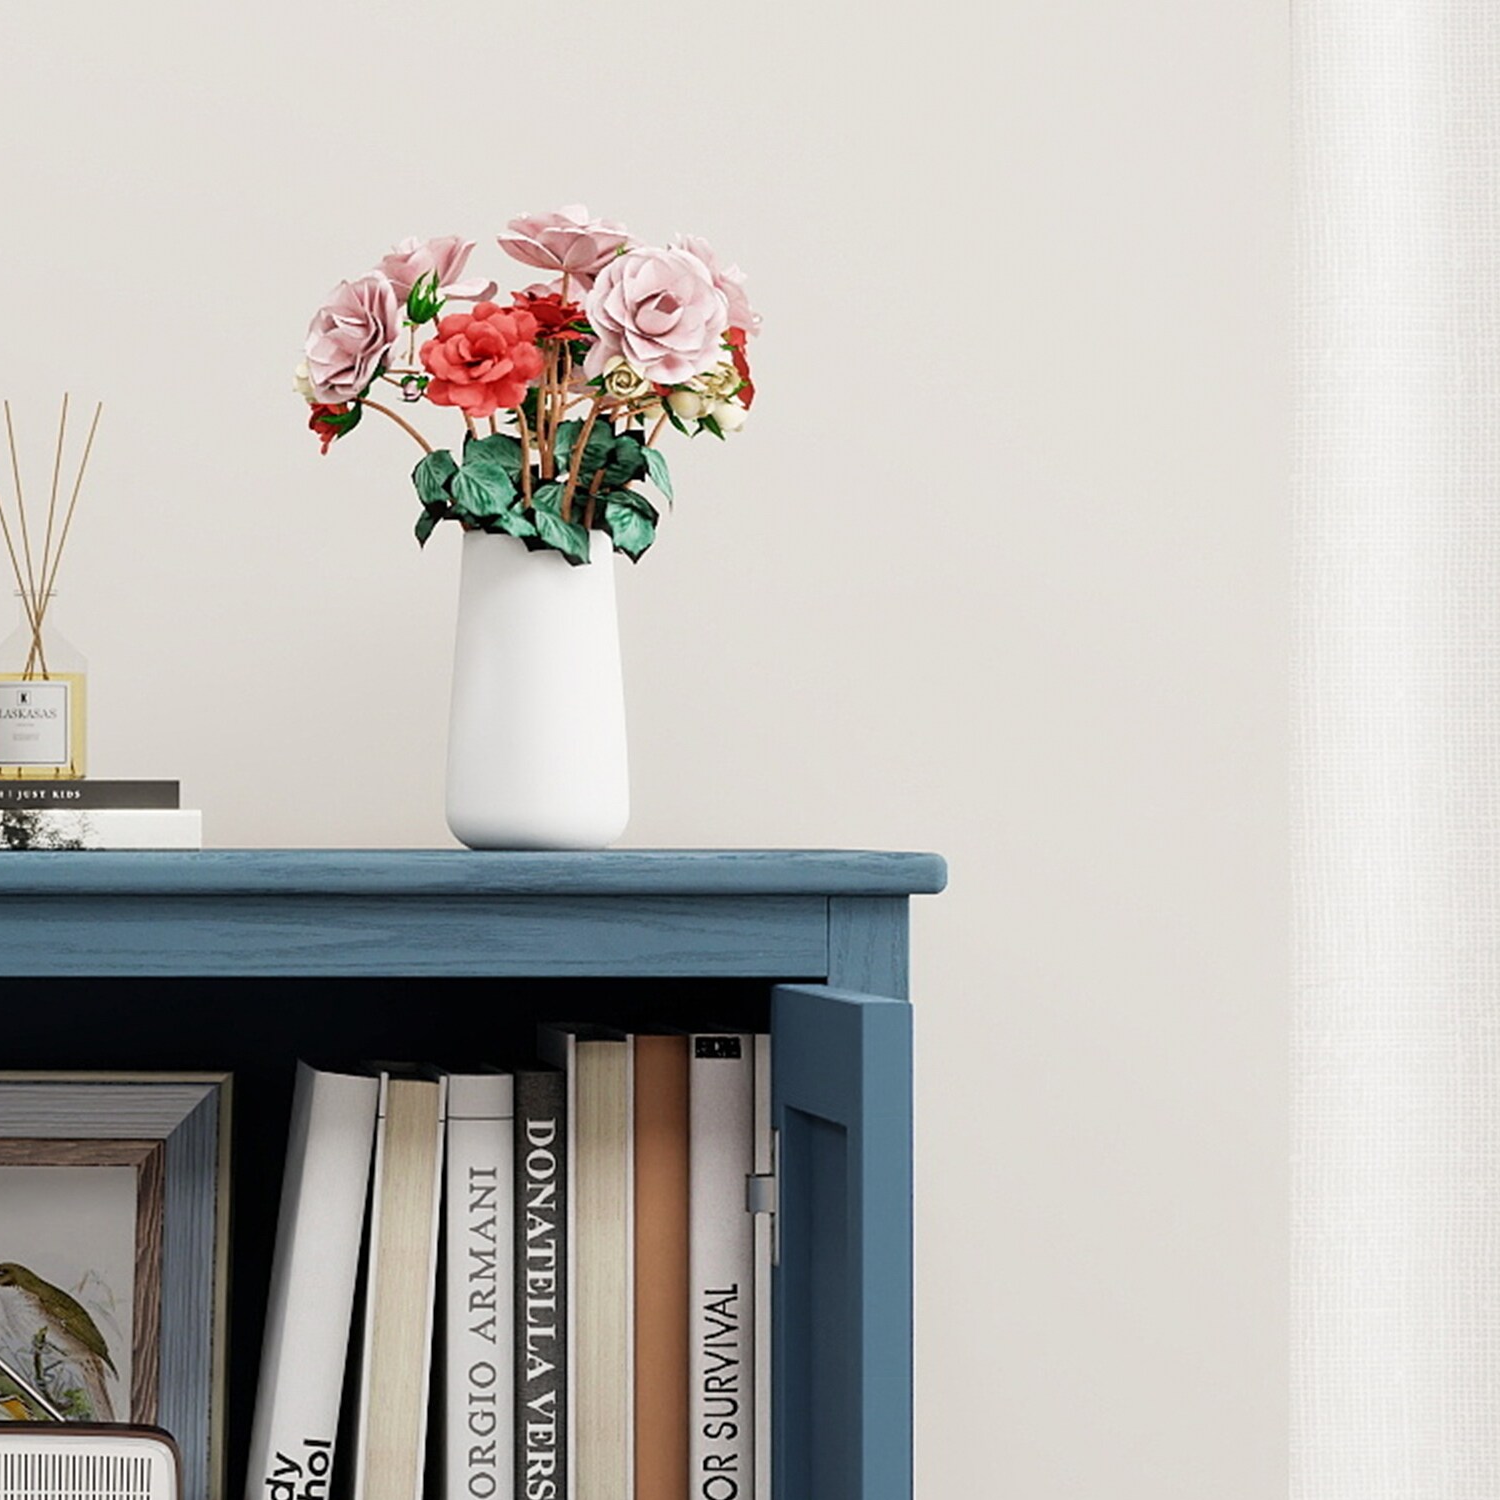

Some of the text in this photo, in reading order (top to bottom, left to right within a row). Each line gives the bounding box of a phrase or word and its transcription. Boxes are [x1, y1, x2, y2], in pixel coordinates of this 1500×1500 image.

[17, 790, 47, 799] JUST
[52, 790, 81, 799] KIDS
[468, 1166, 497, 1344] ARMANI
[526, 1117, 556, 1382] DONATELLA
[702, 1283, 739, 1440] SURVIVAL
